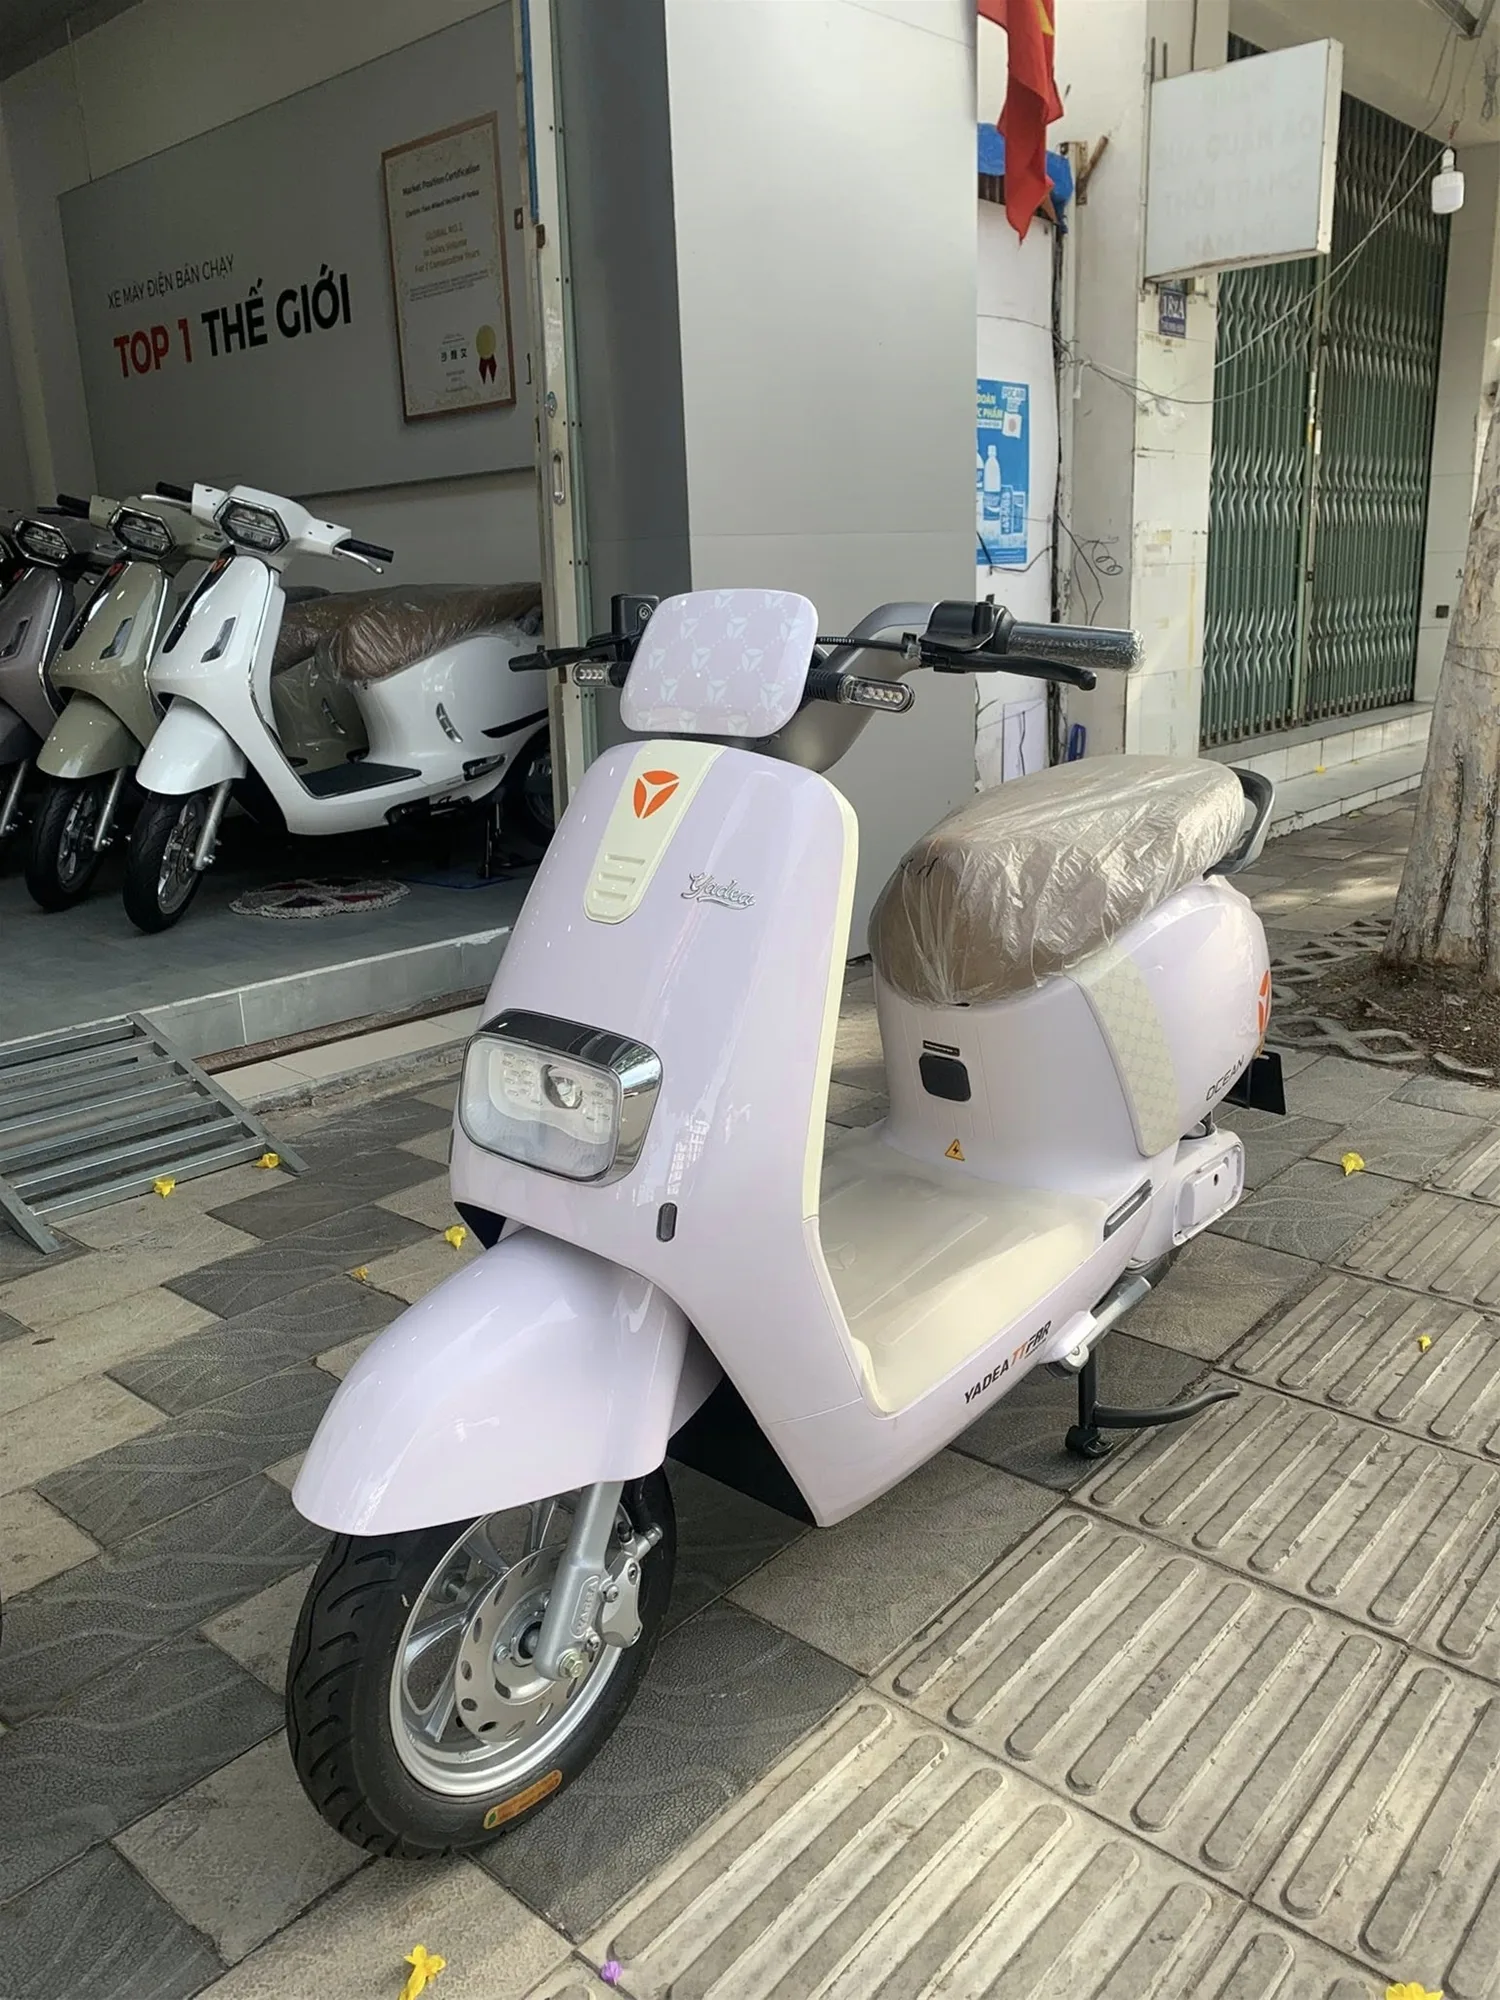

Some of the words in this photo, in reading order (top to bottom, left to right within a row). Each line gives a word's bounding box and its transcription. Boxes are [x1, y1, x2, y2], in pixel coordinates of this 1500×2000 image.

[107, 290, 121, 310] XE
[112, 324, 170, 379] TOP
[177, 316, 193, 364] 1
[200, 276, 269, 358] THẾ
[275, 262, 352, 340] GIỚI
[1205, 1054, 1245, 1101] OCEAN
[963, 1358, 1009, 1404] YADEA
